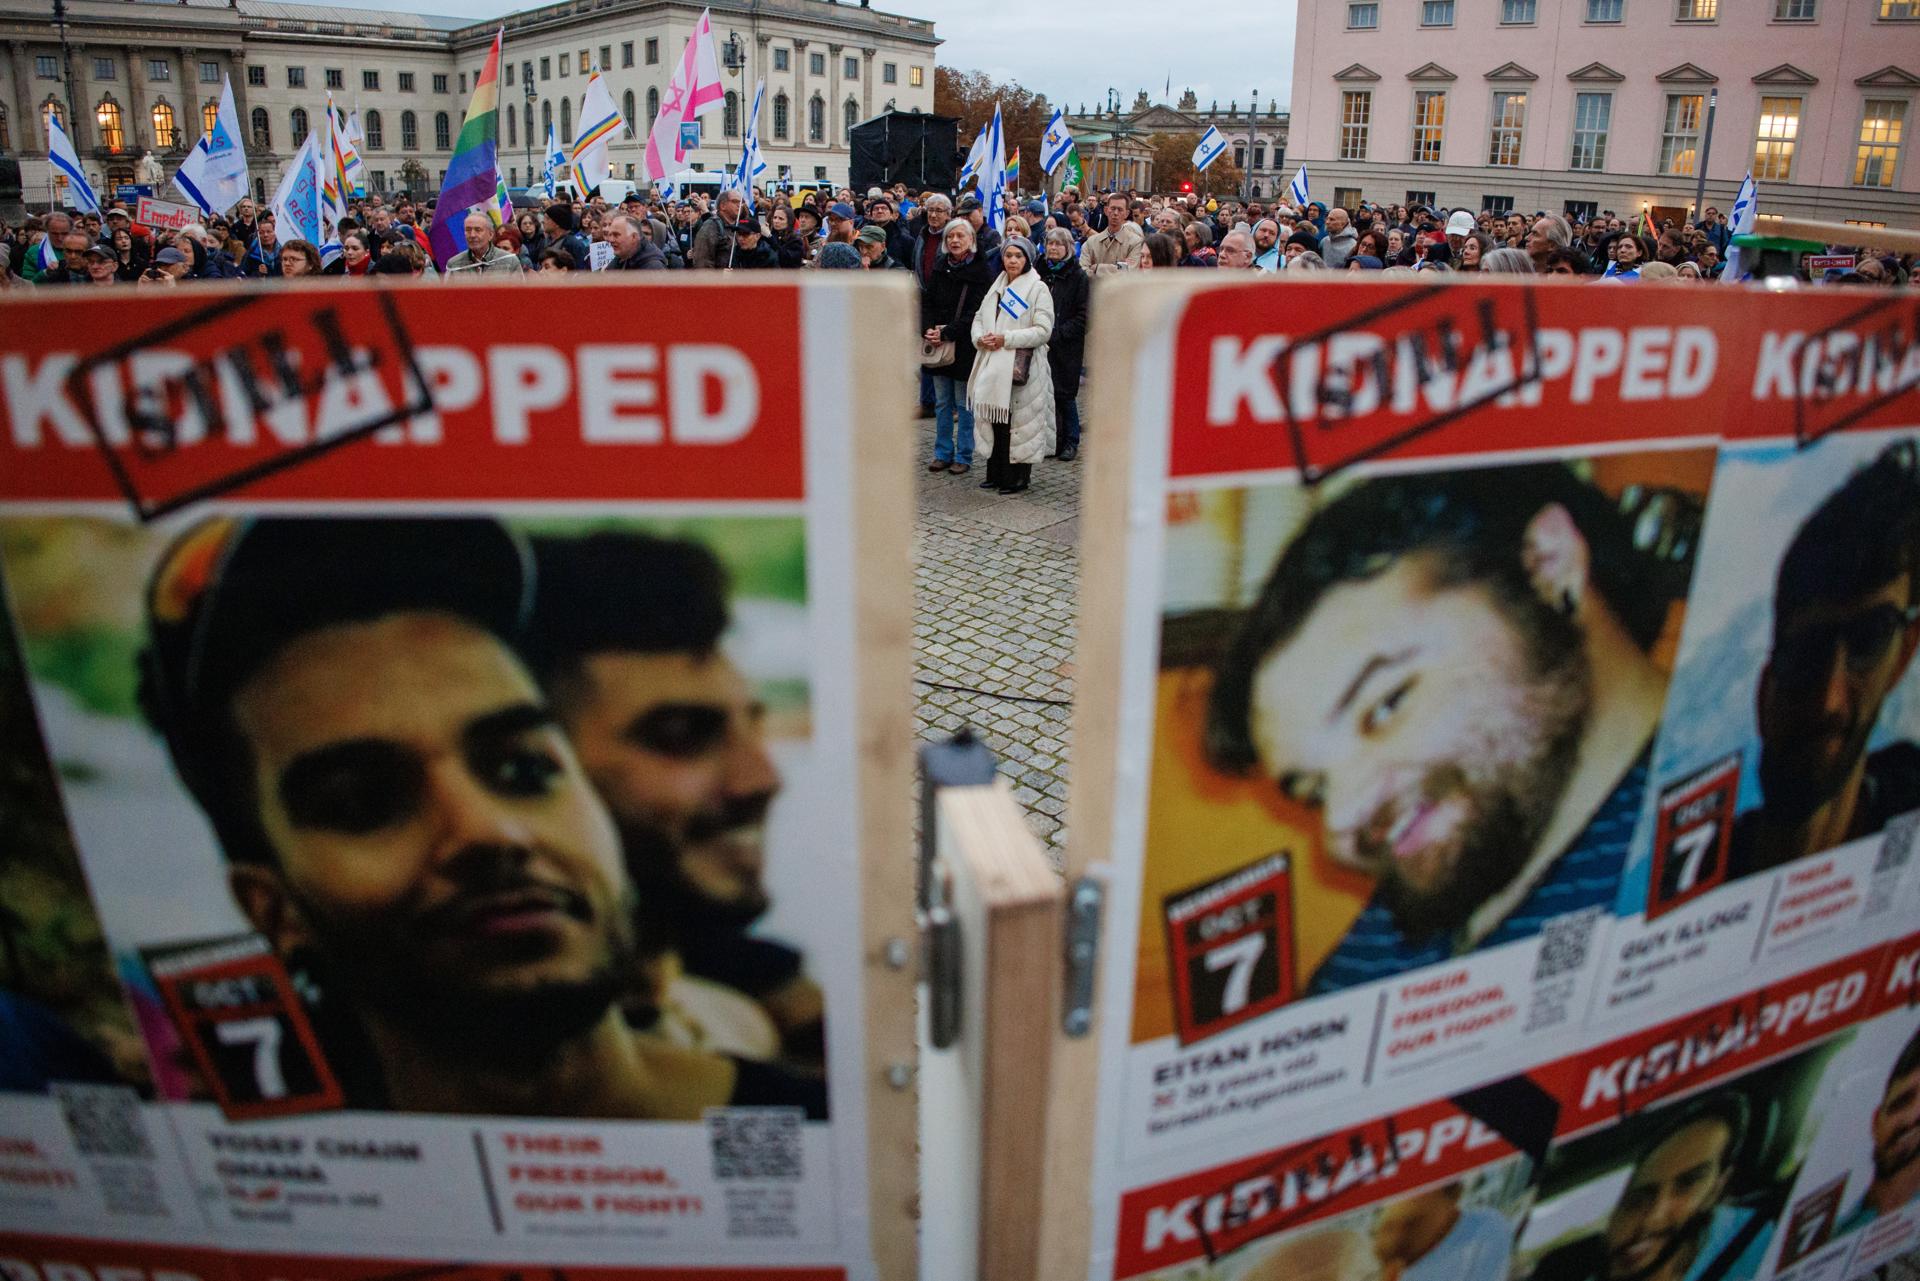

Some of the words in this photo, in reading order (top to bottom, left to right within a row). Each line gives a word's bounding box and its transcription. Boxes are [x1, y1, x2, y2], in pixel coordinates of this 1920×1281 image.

[2, 344, 761, 447] KIDNAPPED
[1206, 325, 1718, 426] KIDNAPPED
[1673, 819, 1717, 892] 7
[1204, 931, 1266, 1016] 7
[215, 1016, 288, 1099] 7
[1579, 971, 1868, 1110] KIDNAPPED
[1142, 1115, 1502, 1252] KIDNAPPE
